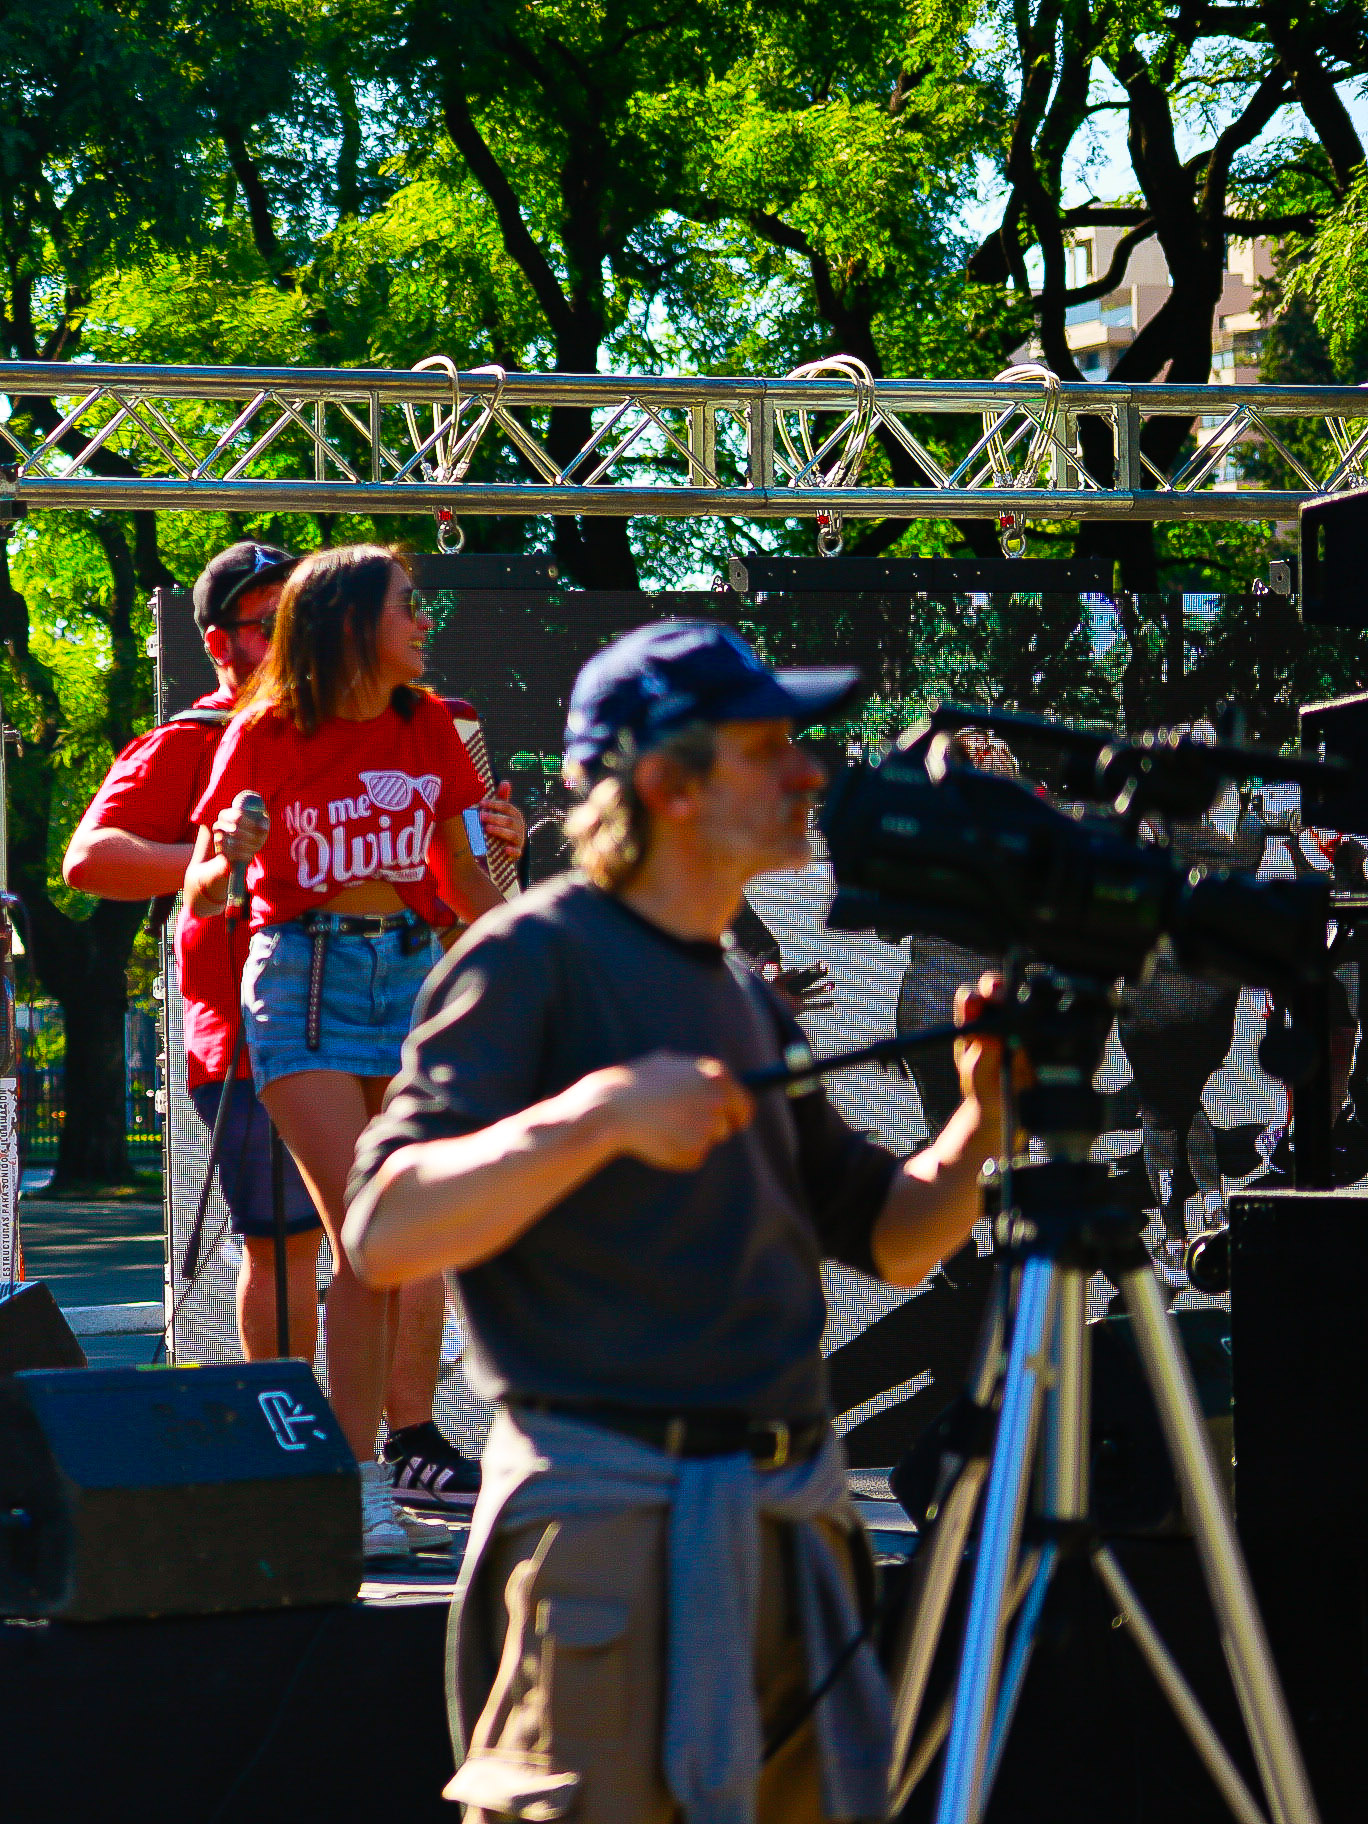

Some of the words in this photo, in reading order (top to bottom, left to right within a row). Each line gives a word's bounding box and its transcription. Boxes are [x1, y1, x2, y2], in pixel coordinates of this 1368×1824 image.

[283, 800, 319, 836] No
[328, 794, 372, 826] me
[290, 808, 436, 889] Olvid
[1, 1157, 9, 1189] SONIDO
[1, 1192, 10, 1214] PARA
[1, 1216, 11, 1277] ESTRUCTURAS
